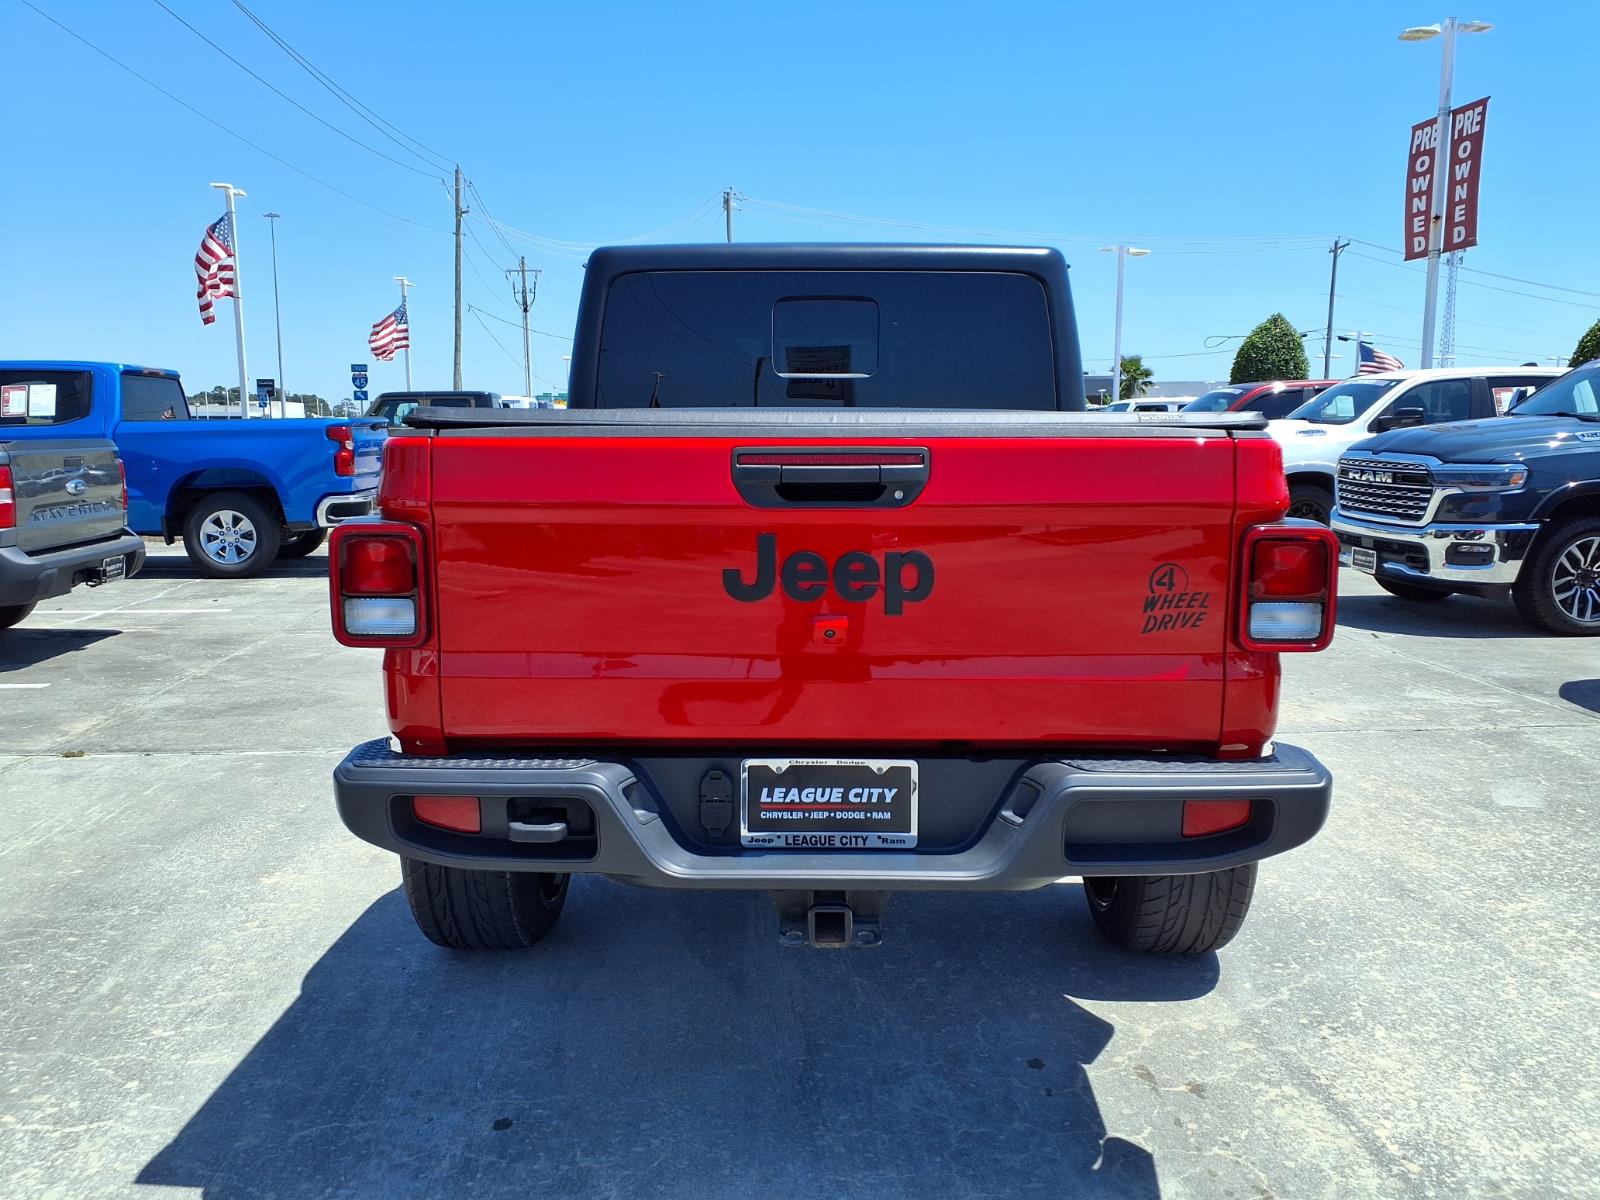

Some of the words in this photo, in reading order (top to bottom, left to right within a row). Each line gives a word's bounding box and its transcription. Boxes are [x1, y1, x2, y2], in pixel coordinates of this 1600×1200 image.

[1454, 106, 1483, 140] PRE
[1453, 140, 1472, 244] OWNED
[1411, 155, 1431, 253] OWNED
[354, 379, 366, 387] 45
[1348, 469, 1393, 483] RAM
[32, 501, 112, 522] MAVERICK
[722, 532, 935, 616] Jeep
[1156, 567, 1176, 592] 4
[1143, 592, 1211, 613] WHEEL
[1142, 611, 1207, 634] DRIVE
[760, 787, 844, 803] LEAGUE
[848, 787, 898, 803] CITY
[760, 811, 803, 819] CHRYSLER
[809, 811, 829, 819] JEEP
[836, 811, 865, 819] DODGE
[872, 811, 891, 819] RAM
[747, 836, 774, 844] Jeep
[785, 835, 836, 846] LEAGUE
[839, 835, 869, 846] CITY
